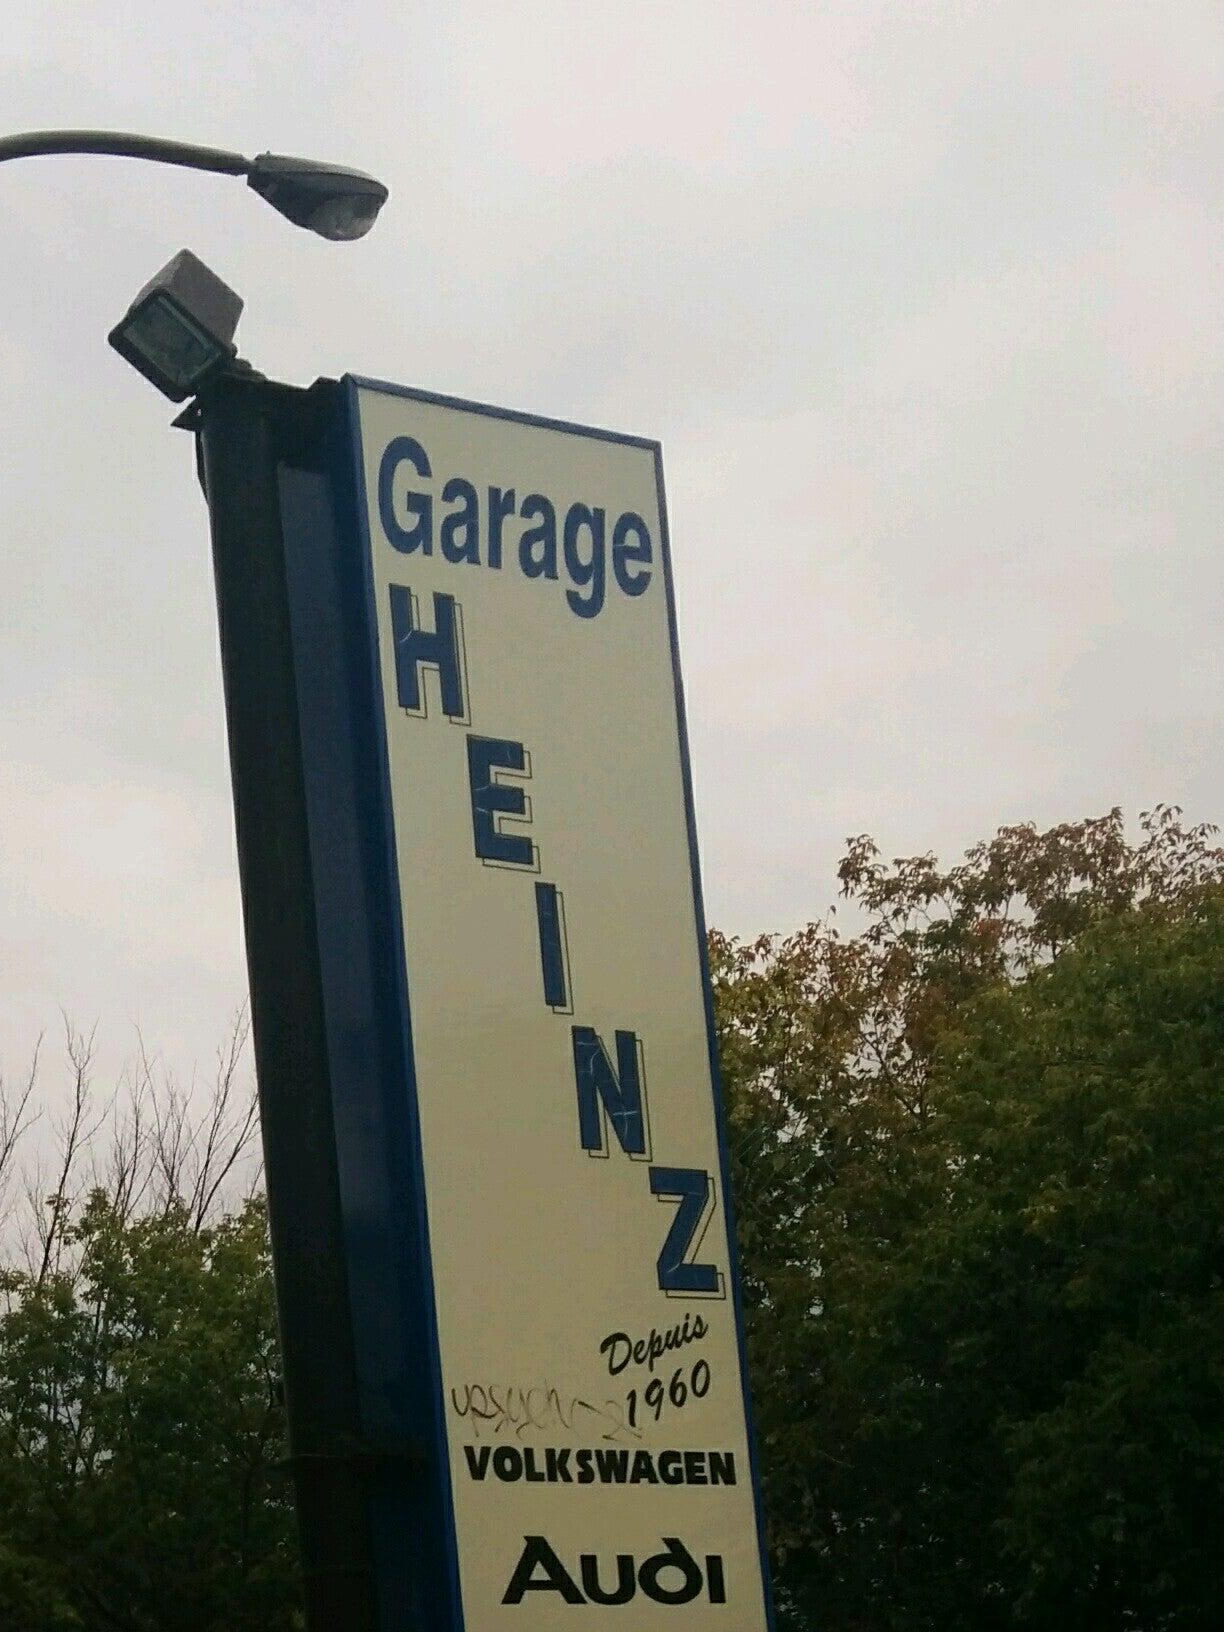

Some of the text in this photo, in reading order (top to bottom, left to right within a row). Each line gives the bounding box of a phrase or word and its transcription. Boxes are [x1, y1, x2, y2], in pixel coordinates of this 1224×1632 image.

[378, 436, 654, 618] Garage
[389, 583, 726, 1299] HEINZ
[599, 1313, 709, 1375] Depuis
[626, 1359, 711, 1427] 1960
[463, 1445, 737, 1485] VOLKSWAGEN
